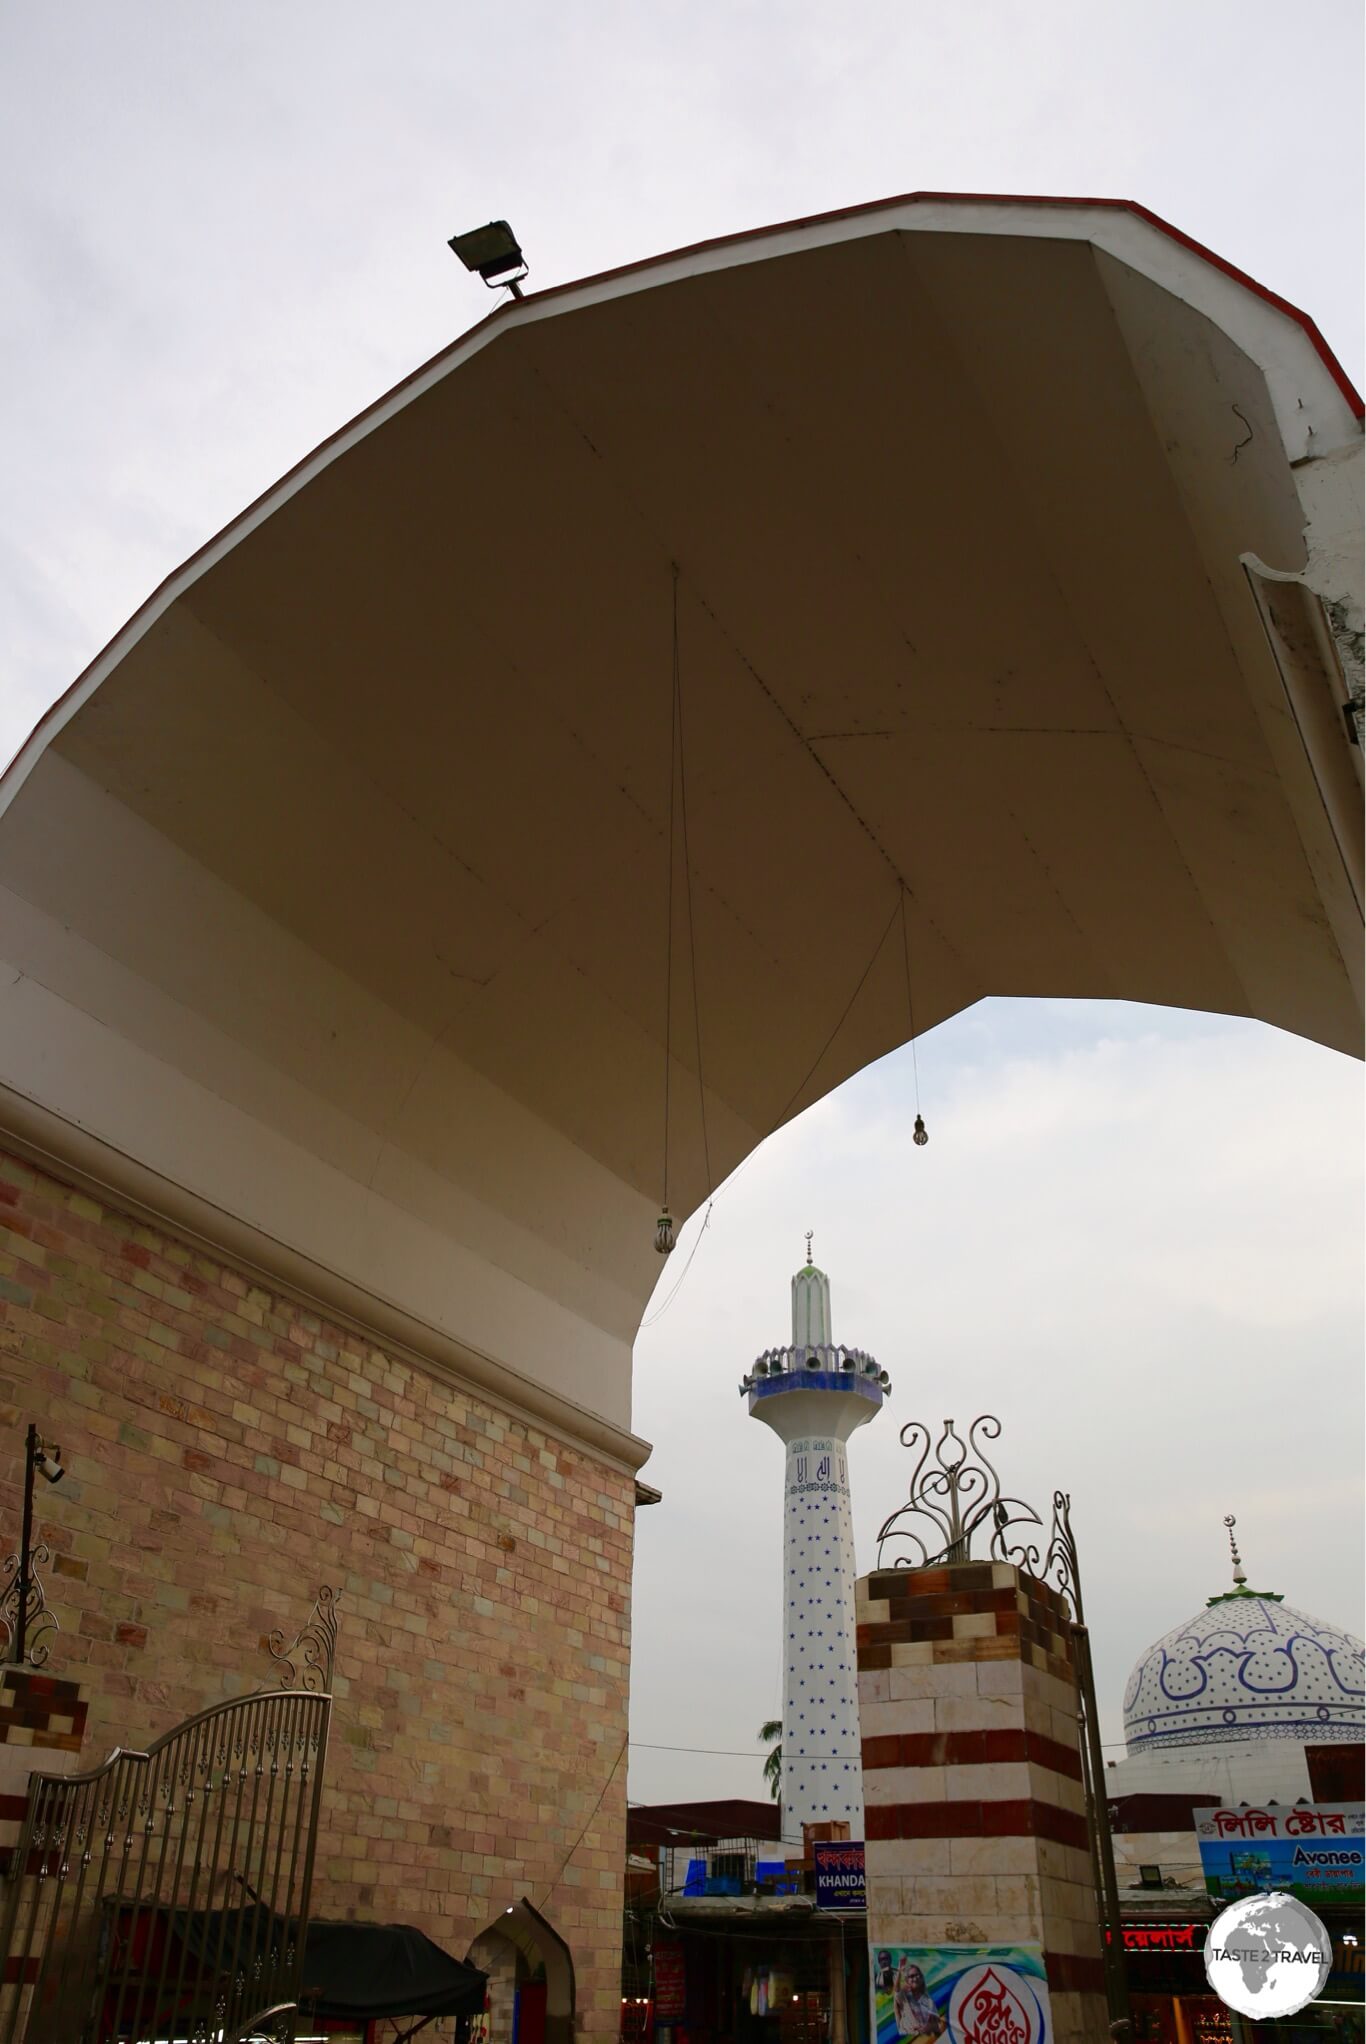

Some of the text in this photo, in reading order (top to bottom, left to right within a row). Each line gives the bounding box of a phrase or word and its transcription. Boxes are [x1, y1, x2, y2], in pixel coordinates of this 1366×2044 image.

[1212, 1809, 1278, 1838] লিলি
[1285, 1808, 1346, 1836] ষ্টোর
[1293, 1846, 1362, 1866] Avonee
